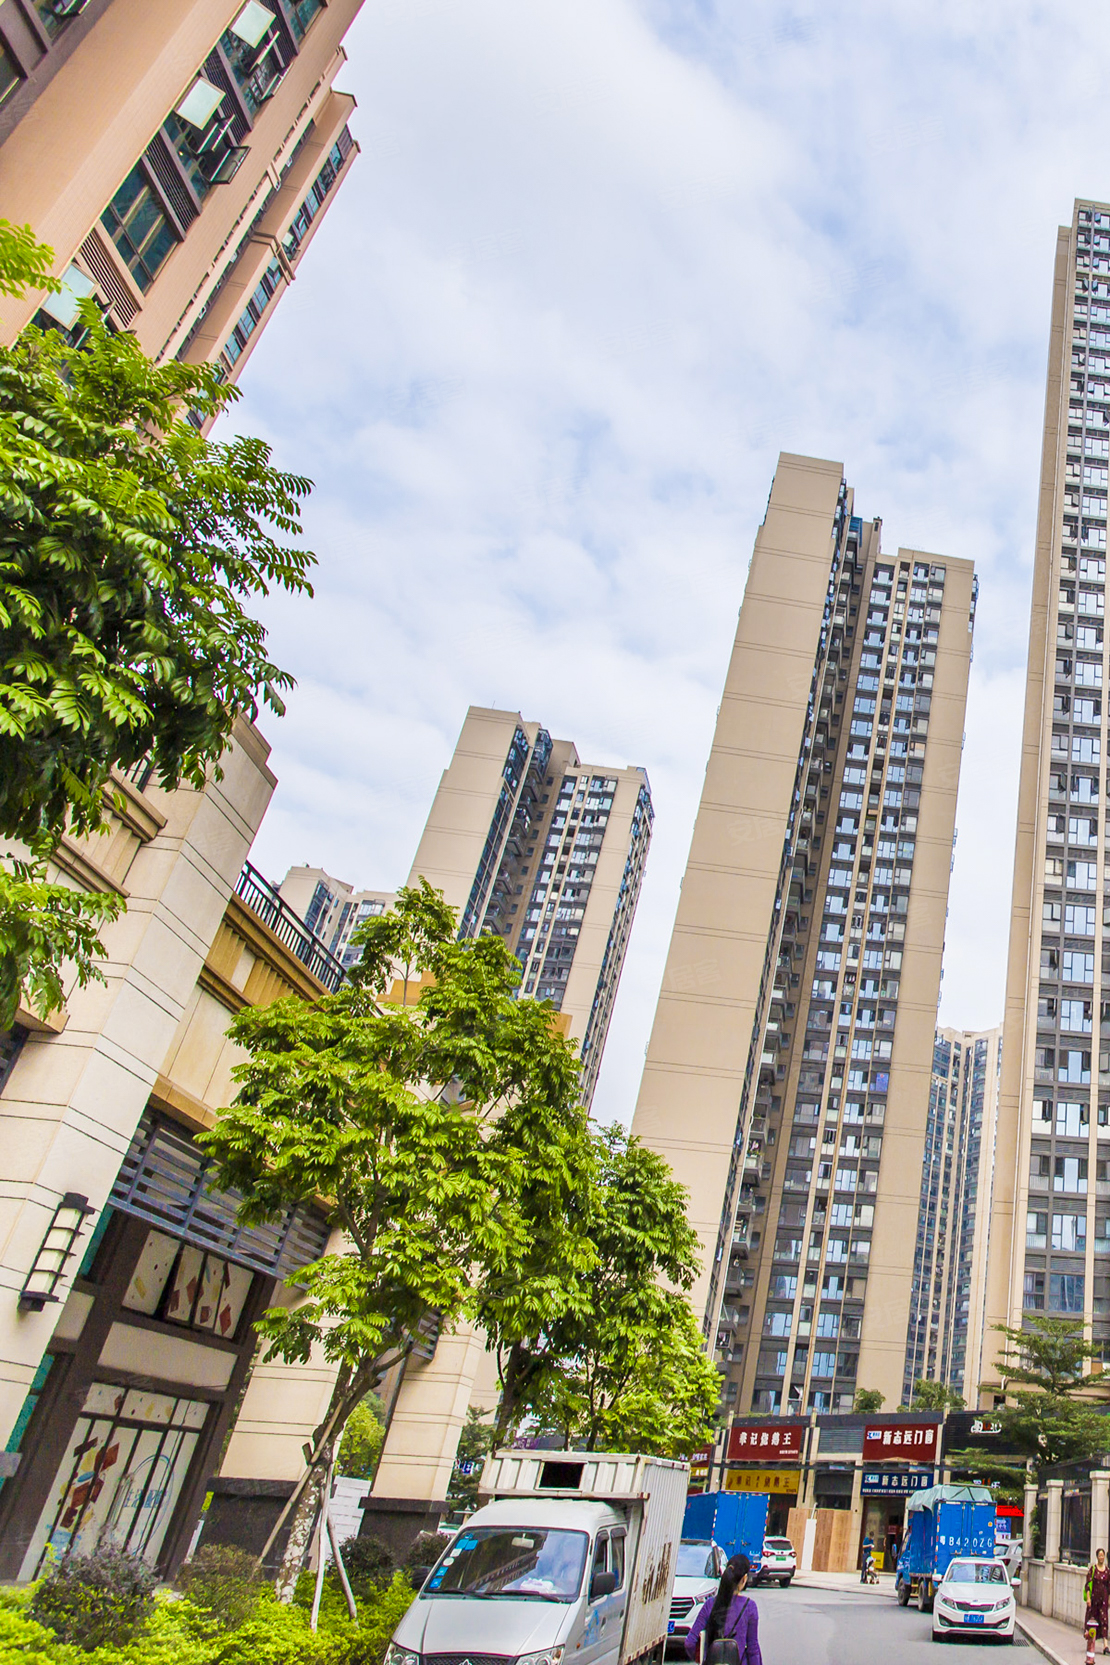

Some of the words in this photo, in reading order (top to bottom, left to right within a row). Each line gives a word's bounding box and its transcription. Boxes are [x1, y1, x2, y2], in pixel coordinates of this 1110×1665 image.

[882, 1429, 934, 1445] 新志远门窗
[881, 1475, 928, 1487] 新志远门窗
